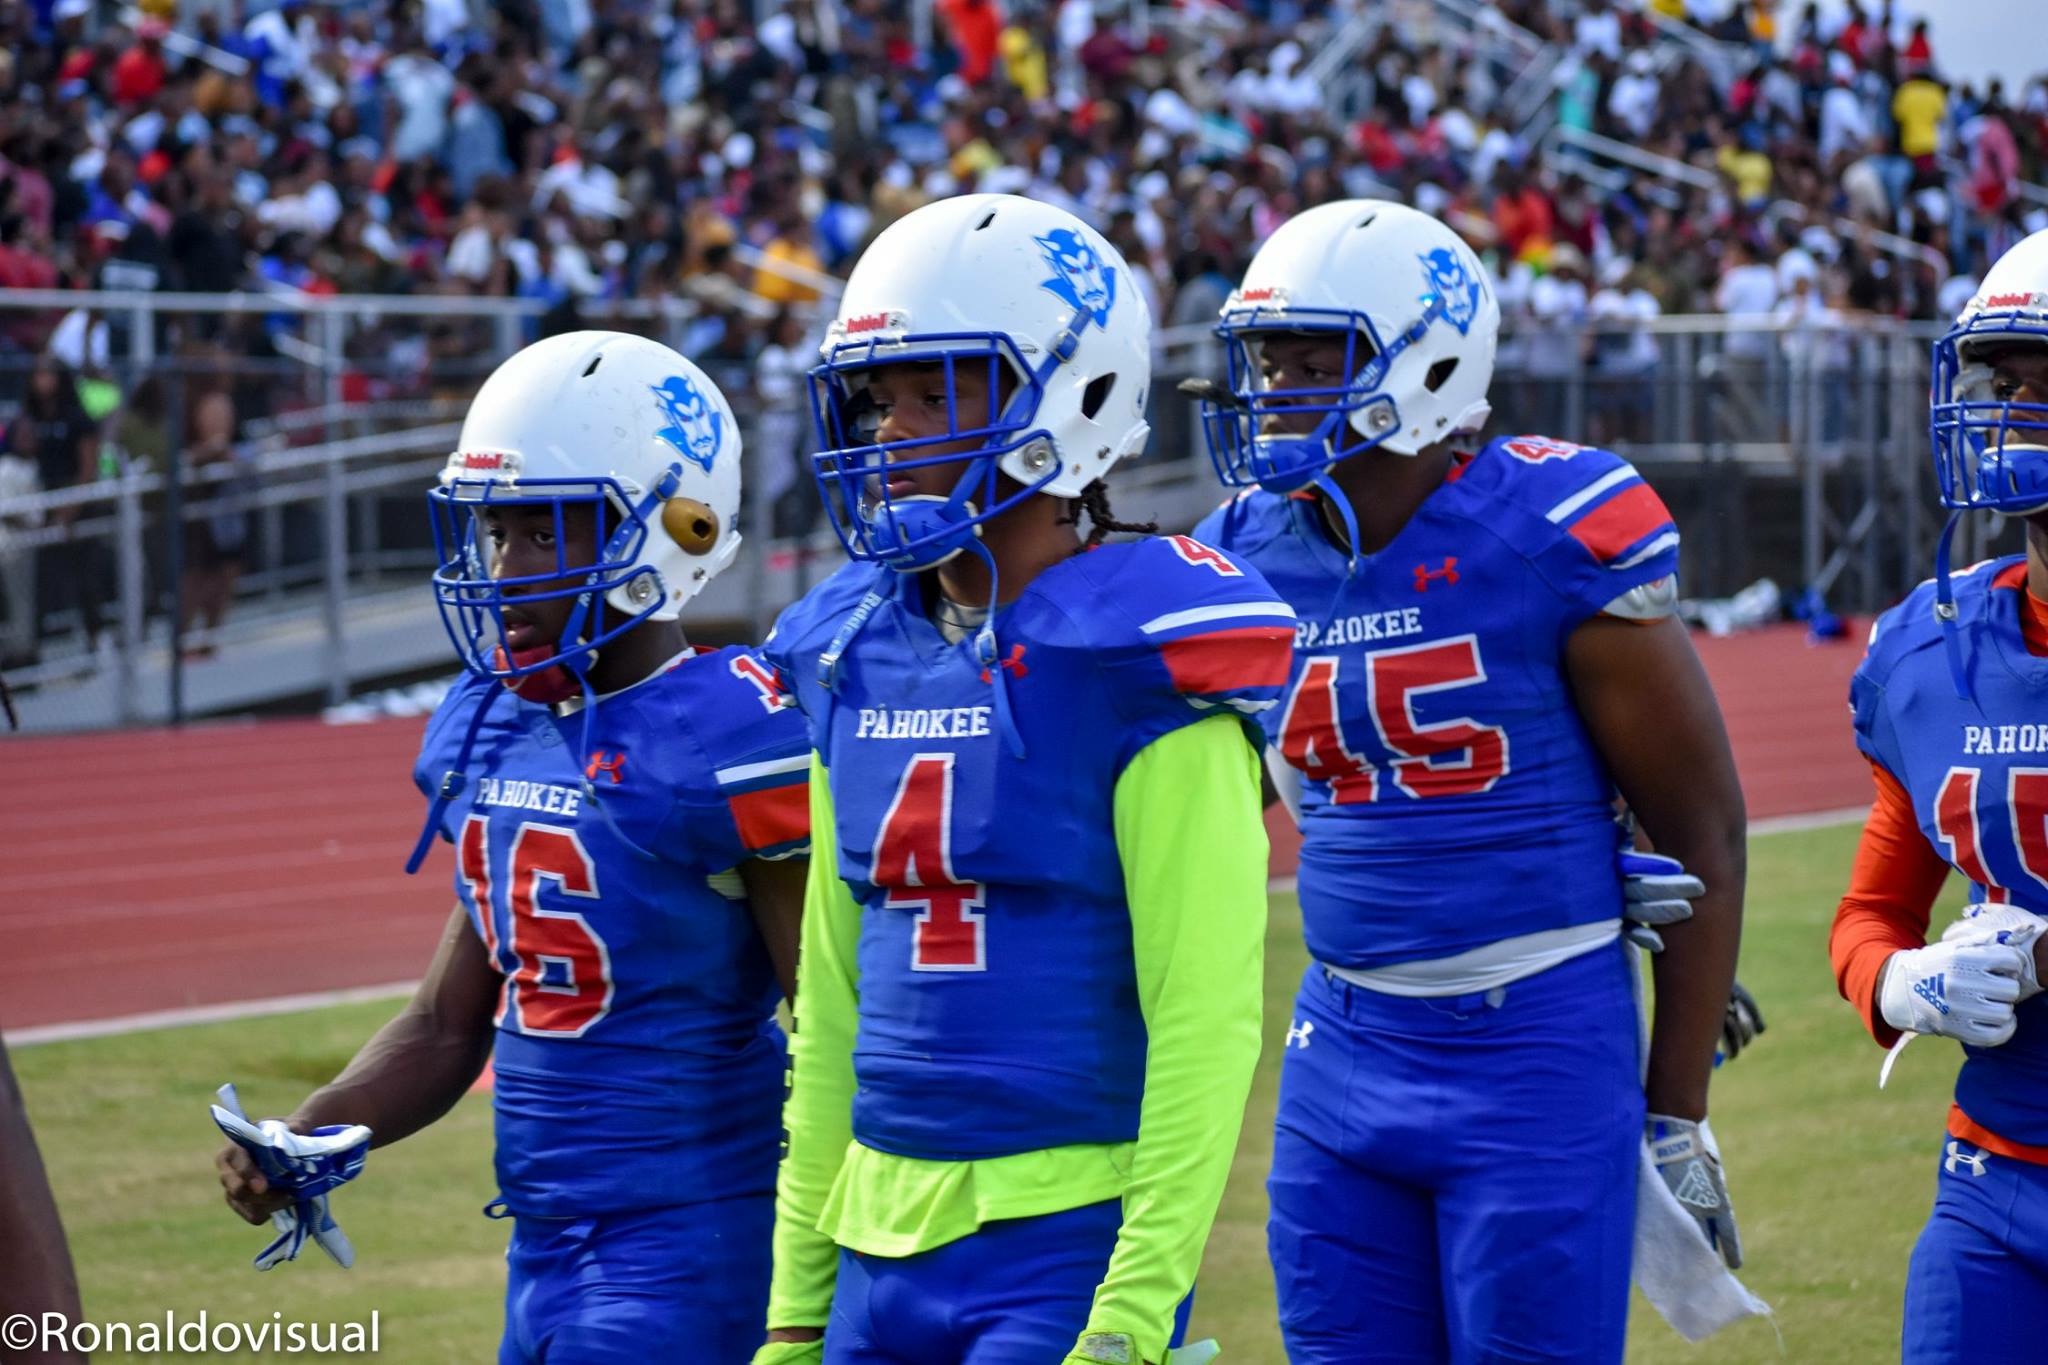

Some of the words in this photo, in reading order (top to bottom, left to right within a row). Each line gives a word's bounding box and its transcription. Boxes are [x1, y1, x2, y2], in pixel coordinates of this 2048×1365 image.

[1164, 535, 1245, 576] 4
[1293, 607, 1423, 649] PAHOKEE
[856, 706, 992, 739] PAHOKEE
[1278, 633, 1511, 807] 45
[475, 778, 583, 816] PAHOKEE
[869, 752, 986, 971] 4
[455, 814, 615, 1039] 16
[1914, 983, 1949, 1015] adidas
